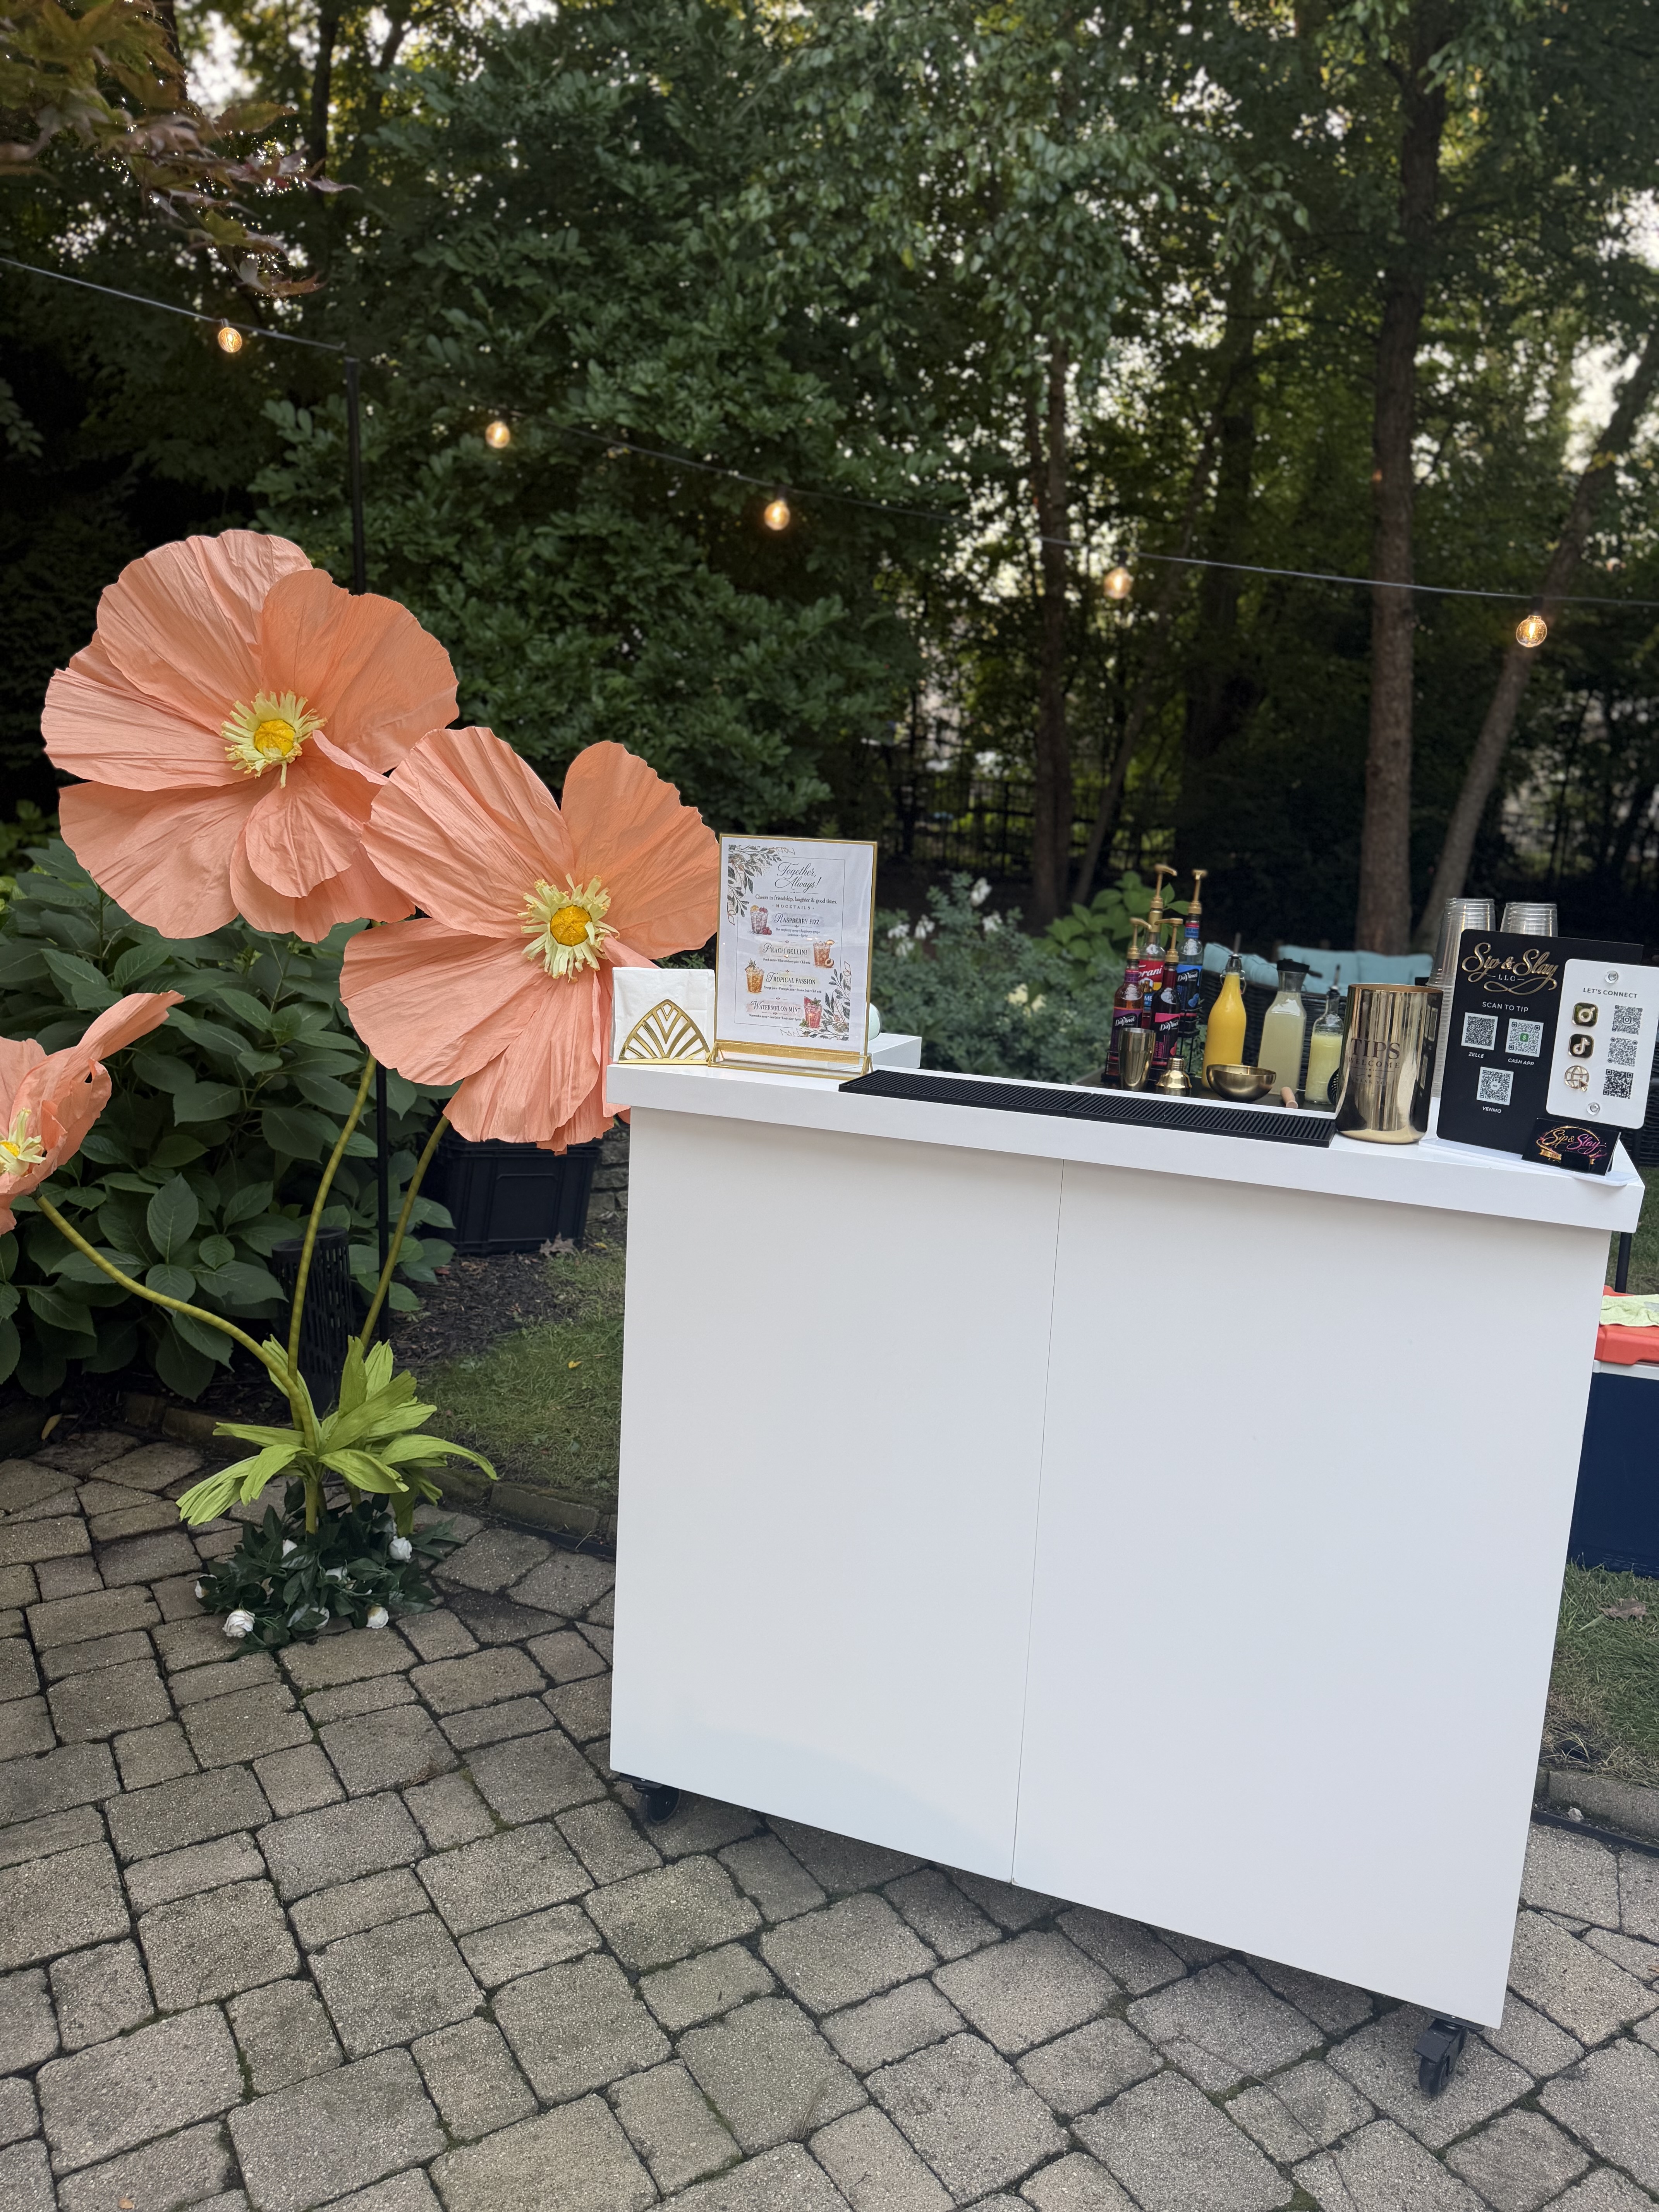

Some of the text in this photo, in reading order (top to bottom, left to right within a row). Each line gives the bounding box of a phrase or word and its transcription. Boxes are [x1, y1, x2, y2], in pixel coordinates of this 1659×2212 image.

[777, 862, 816, 879] Together,
[775, 876, 822, 893] Always!
[1139, 964, 1163, 977] orani
[1462, 942, 1559, 995] Sip & Slay
[1351, 1038, 1400, 1060] TIPS
[1348, 1056, 1400, 1068] WELCOME
[1542, 1130, 1568, 1148] Sip
[1566, 1134, 1600, 1154] Slay
